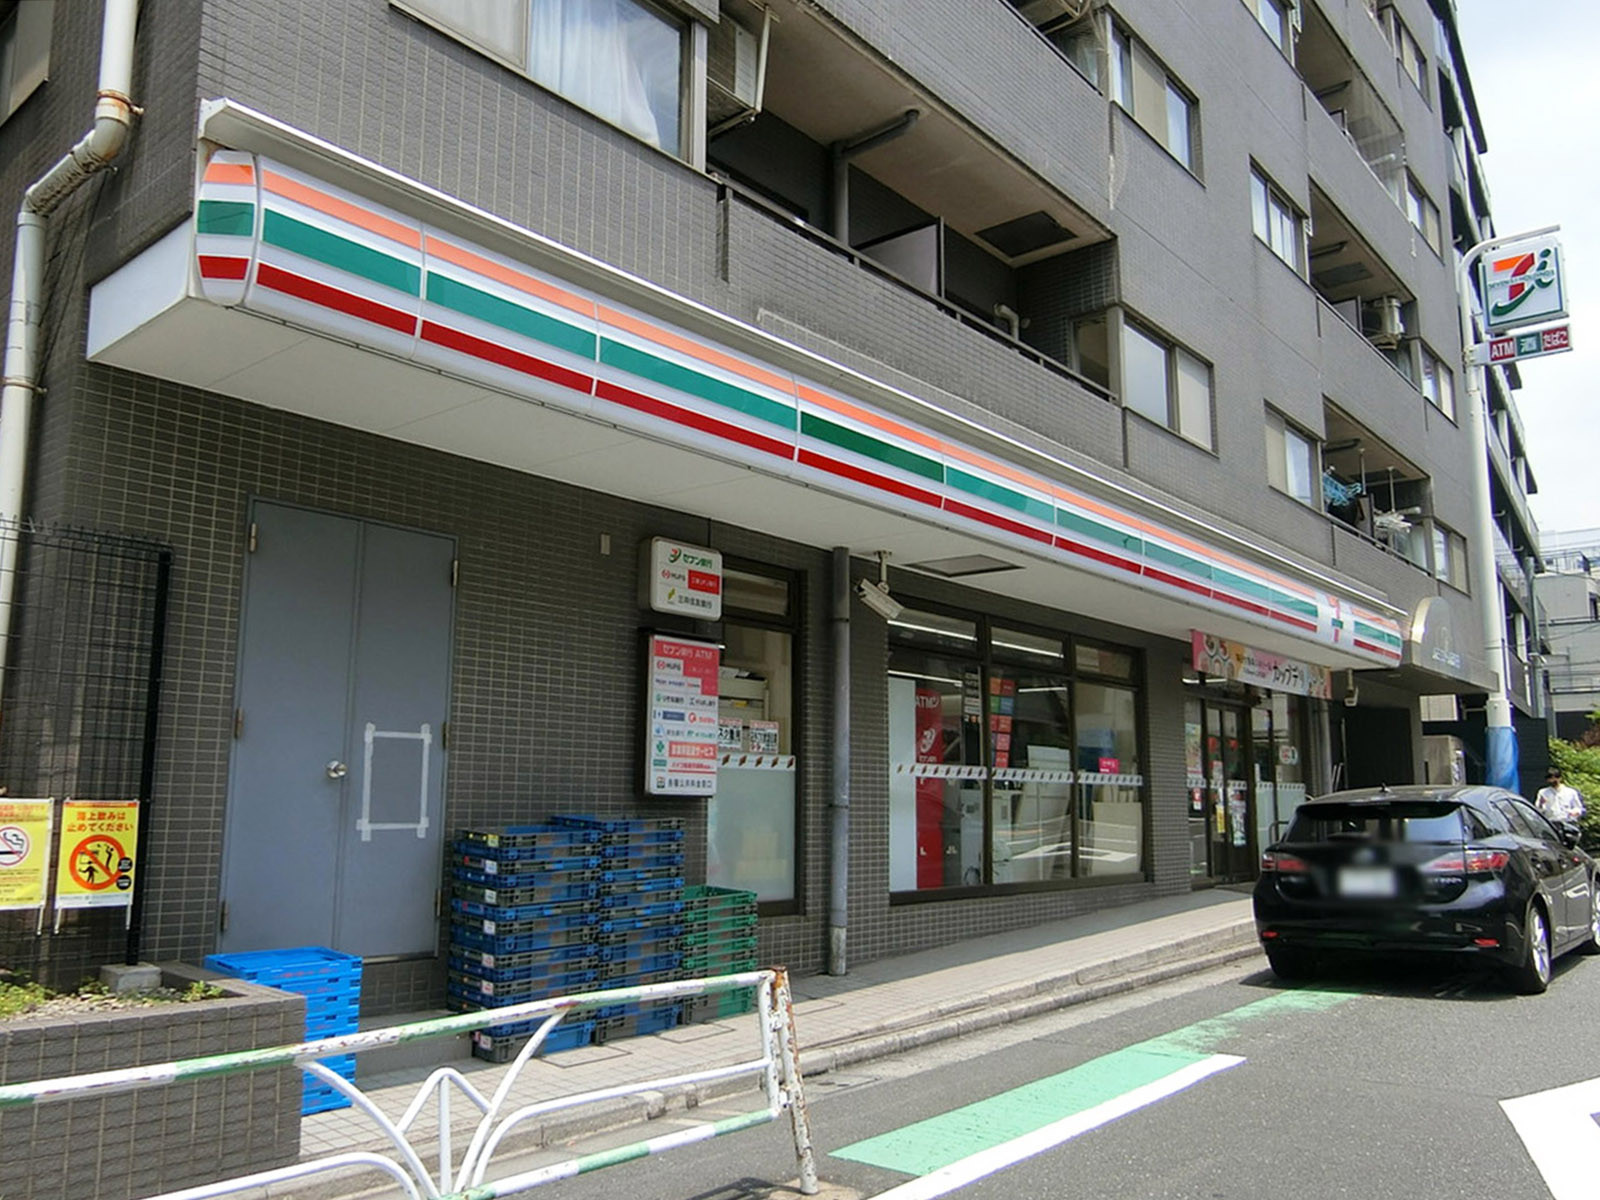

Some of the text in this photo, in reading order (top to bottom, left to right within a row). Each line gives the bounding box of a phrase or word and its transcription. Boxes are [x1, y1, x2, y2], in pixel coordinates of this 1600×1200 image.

[1520, 336, 1537, 353] 酒
[1543, 331, 1568, 348] たばこ
[1491, 340, 1514, 359] ATM
[682, 553, 713, 569] セブン銀行
[67, 823, 134, 832] 止めてください
